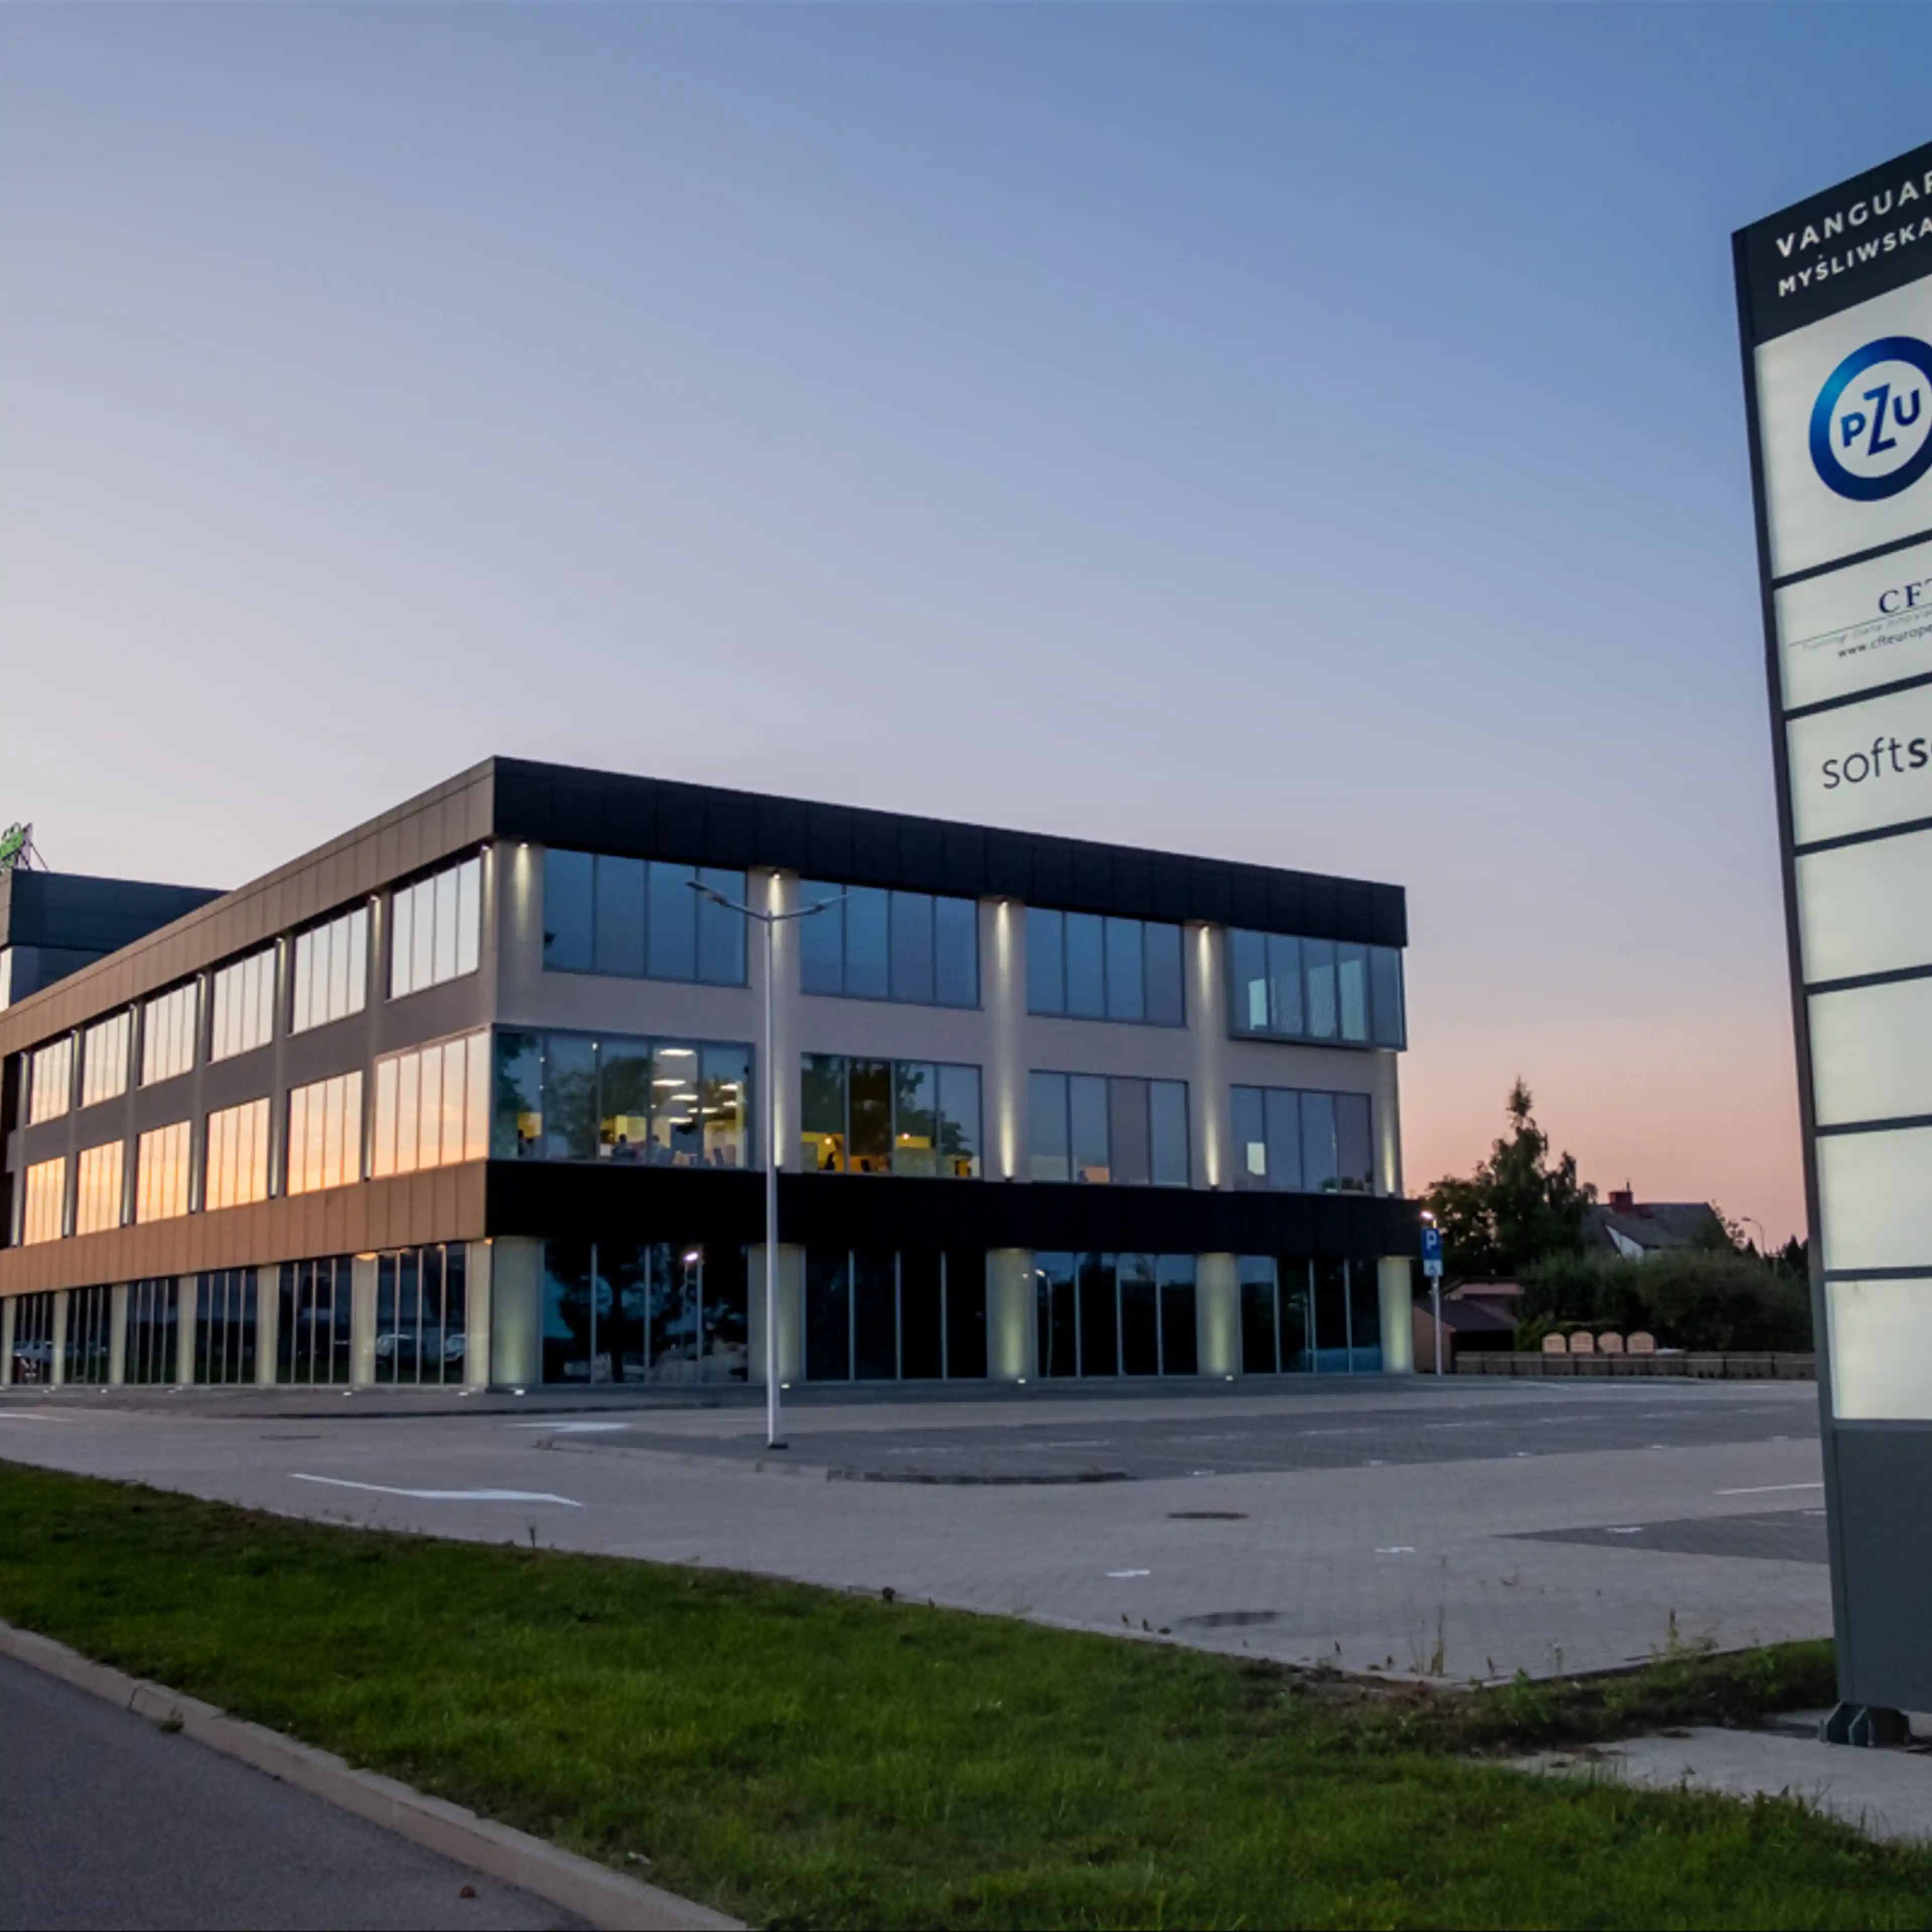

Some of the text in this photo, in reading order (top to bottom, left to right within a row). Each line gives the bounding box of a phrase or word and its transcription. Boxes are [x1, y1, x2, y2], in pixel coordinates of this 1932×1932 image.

[1840, 383, 1921, 456] PZU
[1822, 736, 1932, 790] softs
[1425, 1230, 1437, 1251] P
